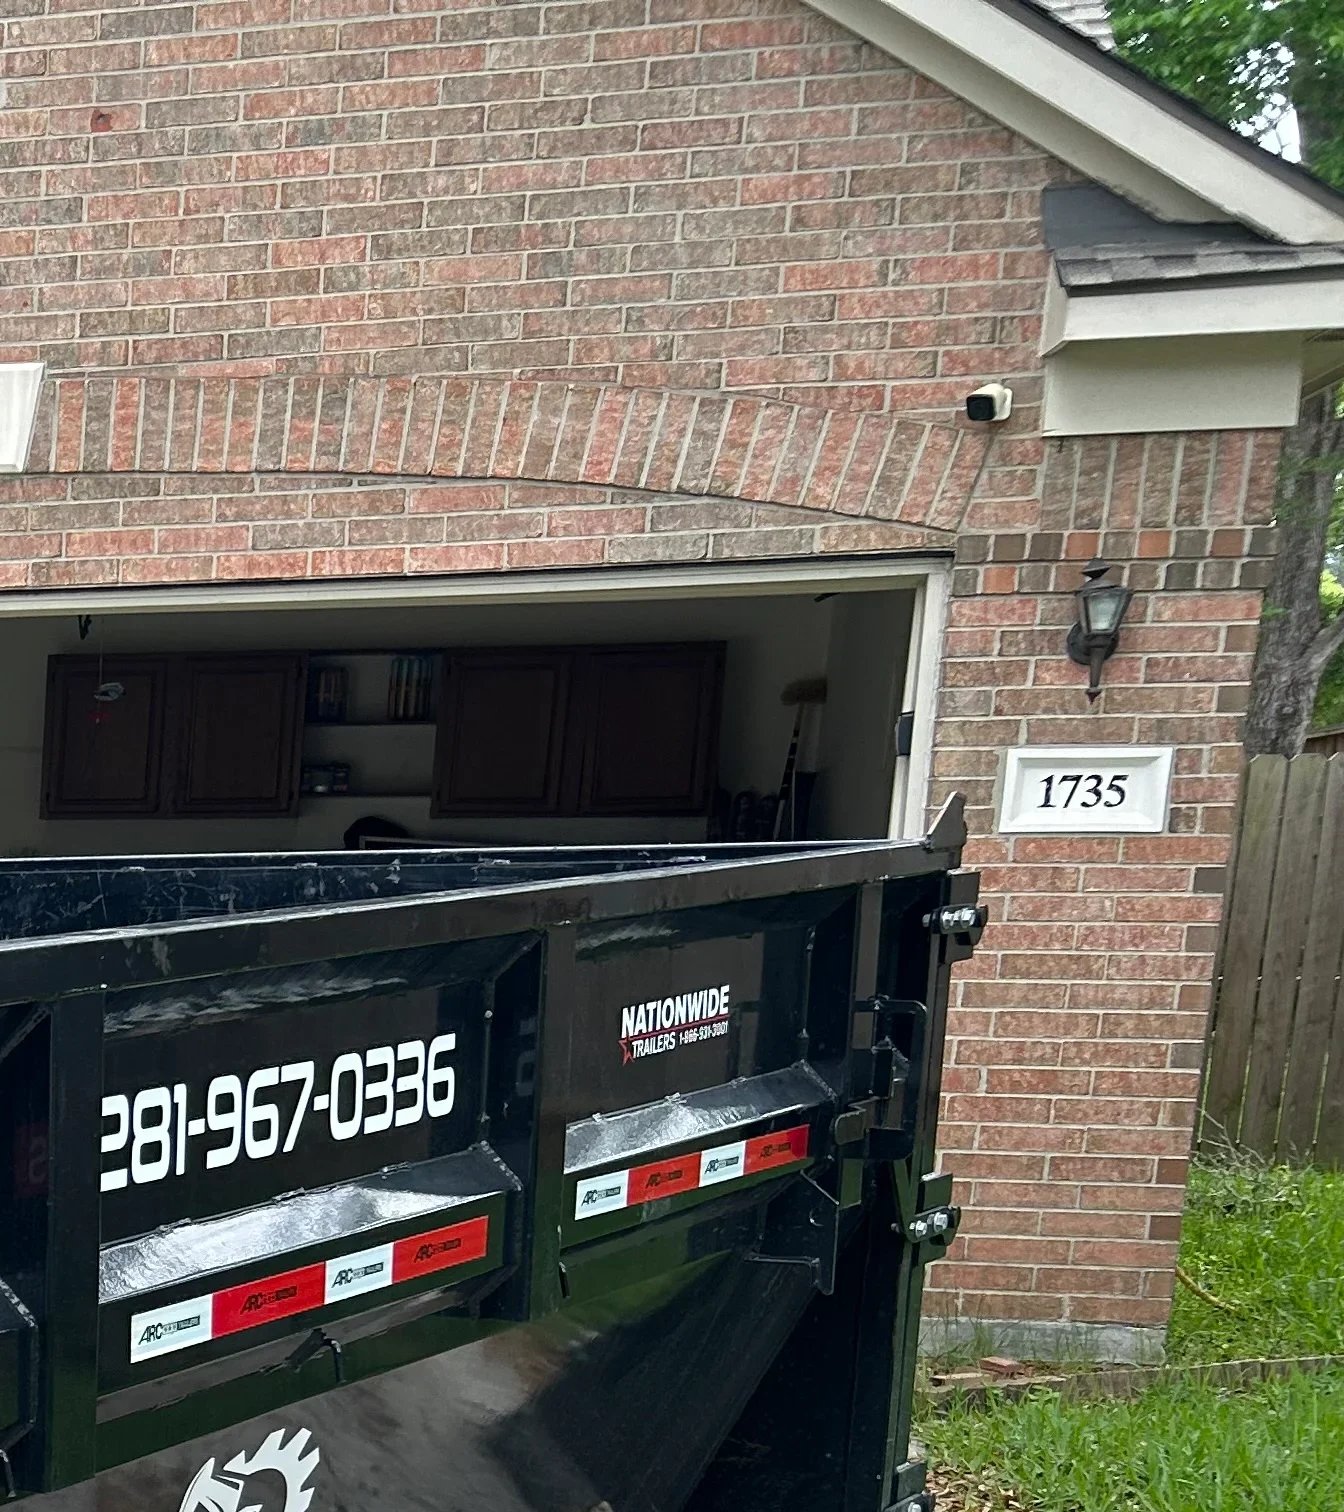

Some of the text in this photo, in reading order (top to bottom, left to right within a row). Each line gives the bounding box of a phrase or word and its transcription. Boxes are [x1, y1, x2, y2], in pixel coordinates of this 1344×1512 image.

[1037, 774, 1130, 809] 1735
[621, 984, 730, 1039] NATIONWIDE
[632, 1031, 677, 1059] TRAILERS
[99, 1032, 457, 1193] 281-967-0336
[581, 1189, 598, 1207] ARC
[331, 1267, 353, 1289] ARC
[138, 1322, 163, 1346] ARC
